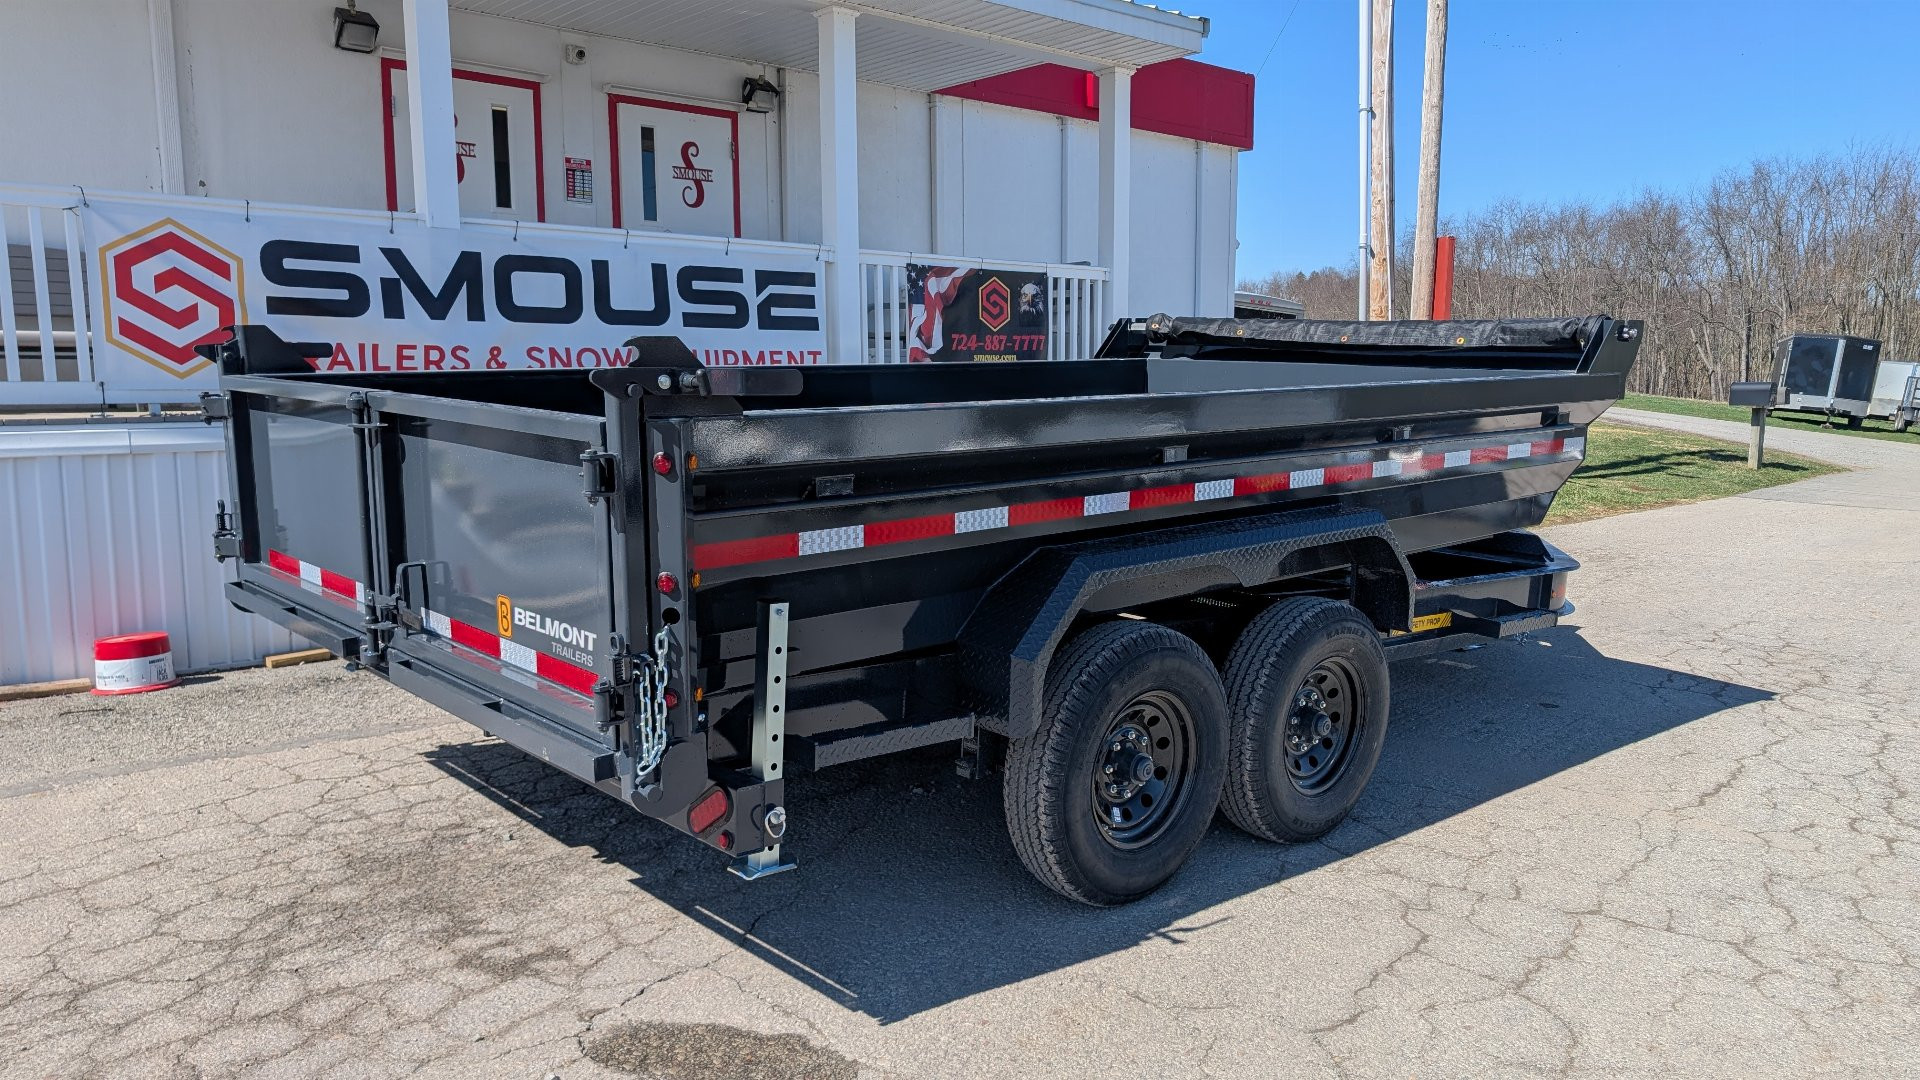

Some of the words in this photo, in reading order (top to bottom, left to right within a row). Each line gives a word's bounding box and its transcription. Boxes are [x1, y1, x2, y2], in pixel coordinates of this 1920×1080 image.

[672, 167, 713, 182] SMOUSE
[260, 239, 820, 331] SMOUSE
[951, 333, 1046, 351] 724-887-7777
[303, 342, 471, 372] AILERS
[486, 345, 508, 369] &
[526, 346, 633, 369] SNOW
[973, 354, 1017, 363] smouse.com
[514, 606, 597, 652] BELMONT
[551, 641, 594, 667] TRAILERS
